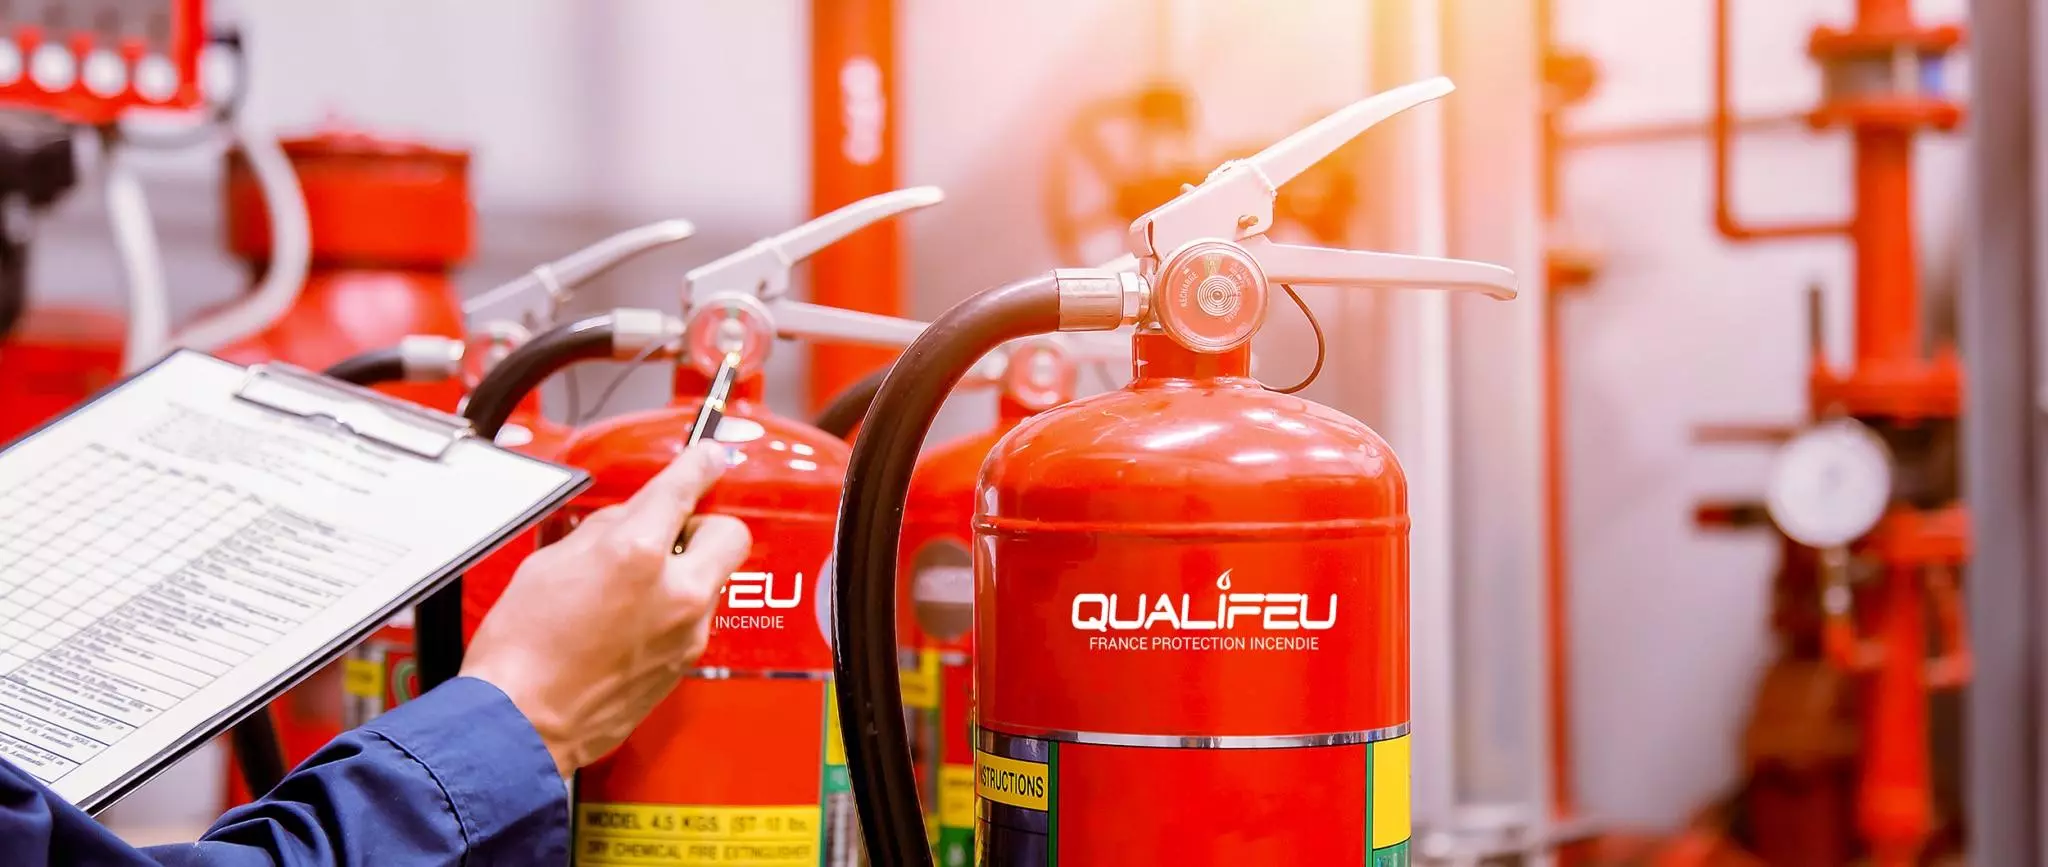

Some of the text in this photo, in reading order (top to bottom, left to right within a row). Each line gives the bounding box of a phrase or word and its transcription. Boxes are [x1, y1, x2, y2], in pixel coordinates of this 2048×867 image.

[720, 572, 803, 608] EU
[715, 616, 784, 629] INCENDIE
[1071, 592, 1338, 632] QUALIFEU
[1089, 636, 1319, 650] FRANCE PROTECTION INCENDIE
[980, 765, 1044, 798] STRUCTIONS
